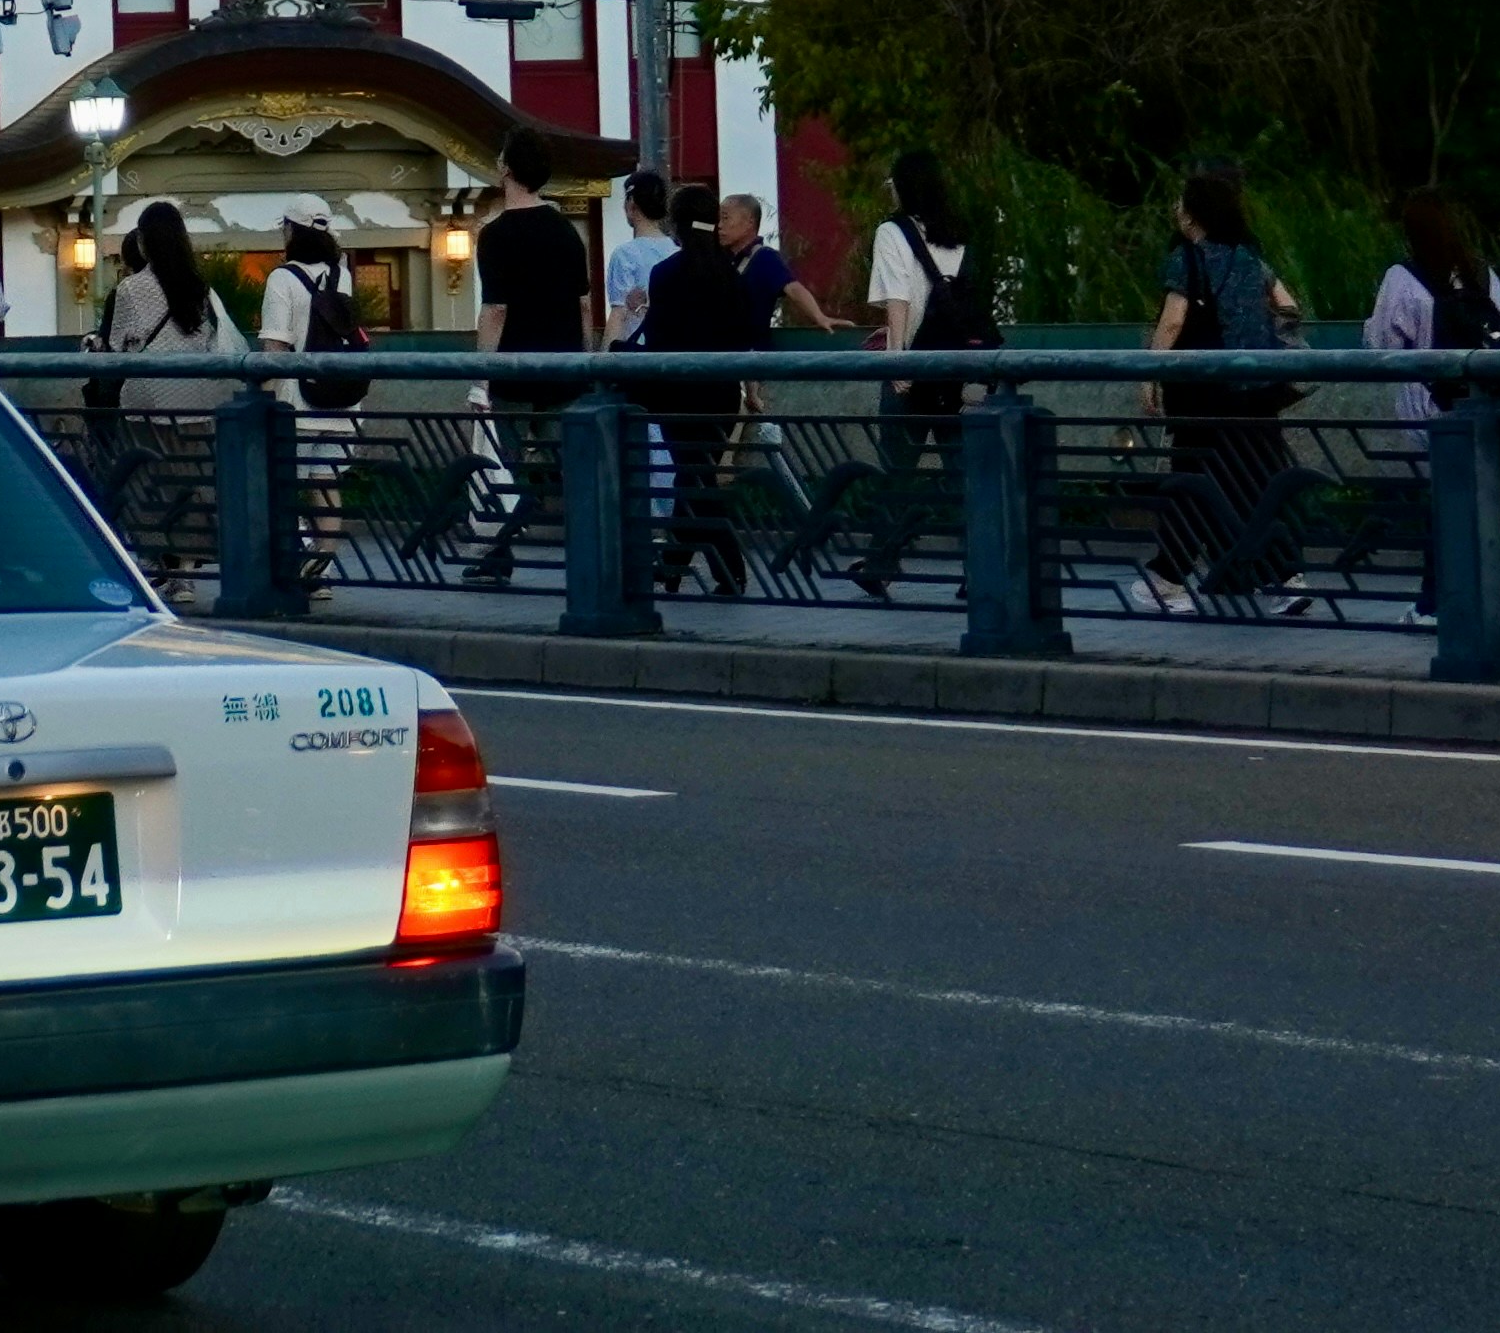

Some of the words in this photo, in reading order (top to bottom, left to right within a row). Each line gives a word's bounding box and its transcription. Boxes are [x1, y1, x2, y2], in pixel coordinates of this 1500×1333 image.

[222, 692, 280, 724] 無線
[318, 687, 389, 718] 2081
[289, 727, 409, 752] COMFORT
